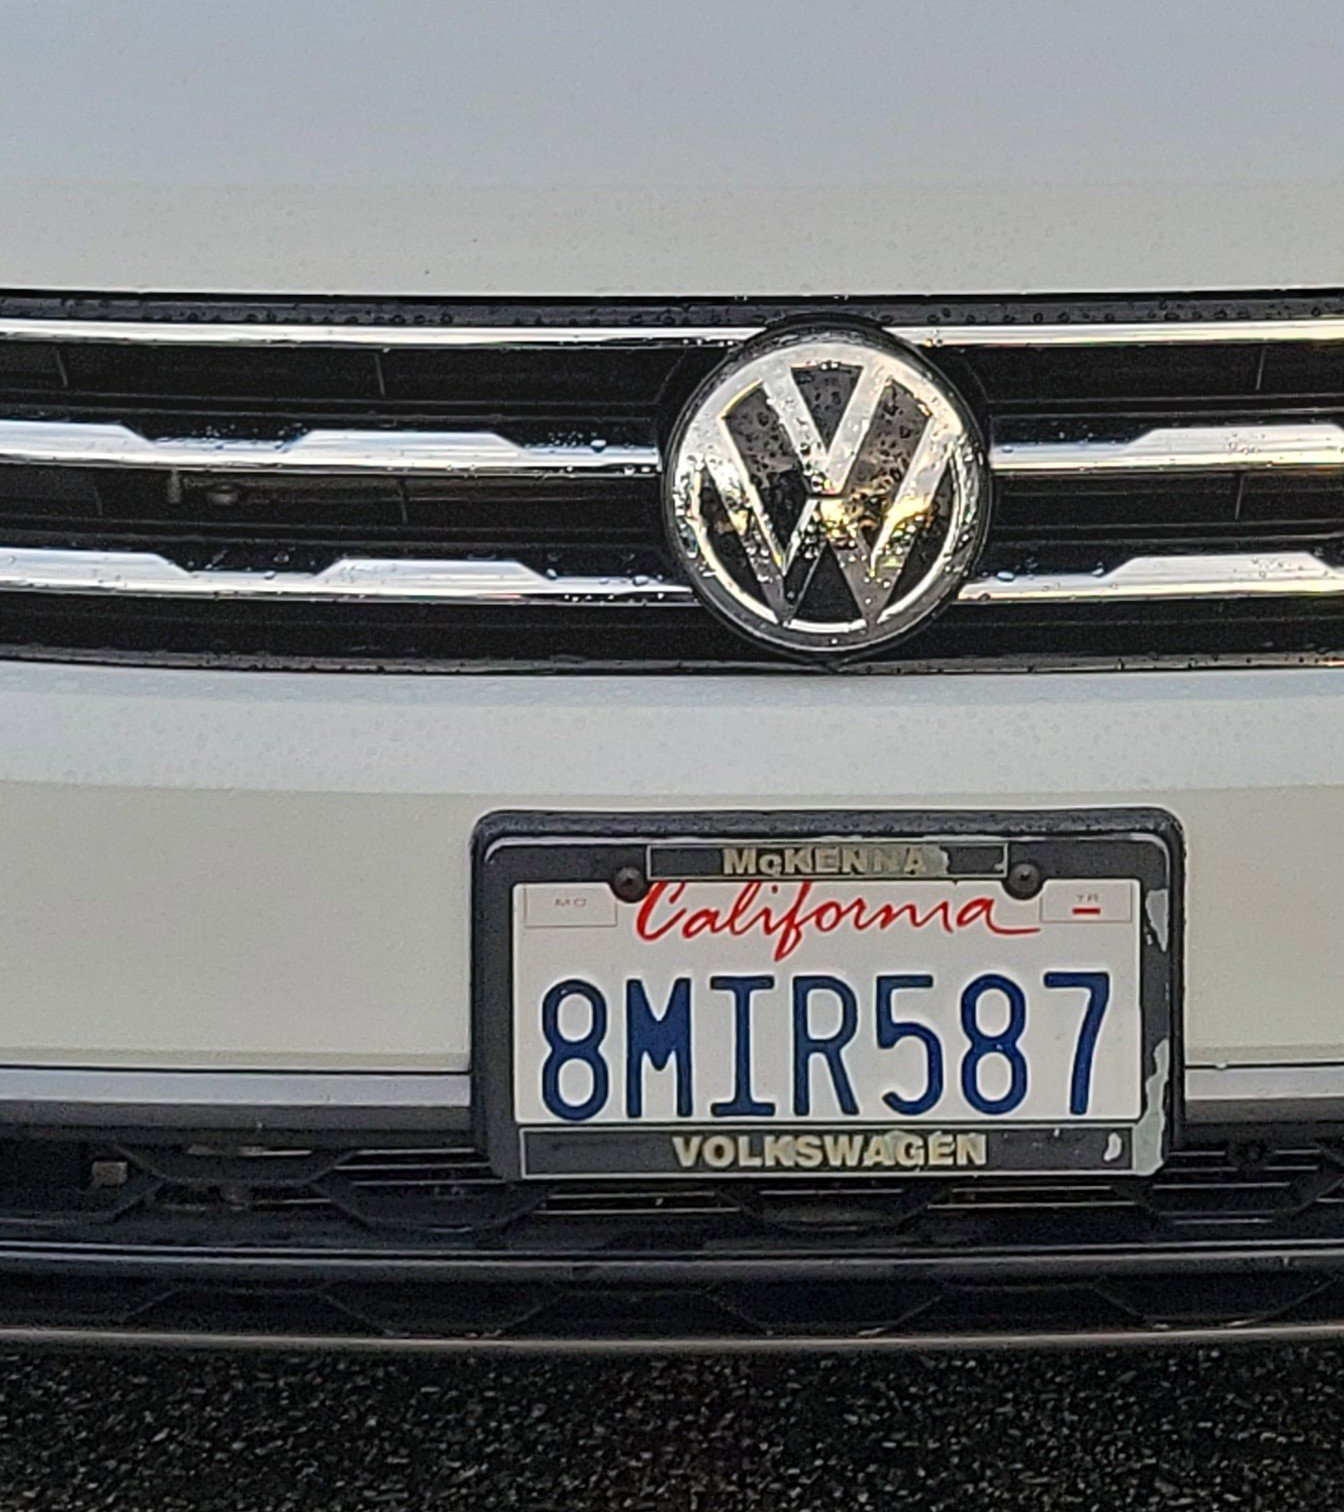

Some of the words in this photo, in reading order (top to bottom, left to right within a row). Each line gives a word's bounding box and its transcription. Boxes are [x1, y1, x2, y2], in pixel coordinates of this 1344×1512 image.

[722, 845, 928, 876] McKENNA
[635, 879, 1042, 962] California
[540, 970, 1112, 1123] 8MIR587
[671, 1133, 988, 1168] VOLKSWAGEN
